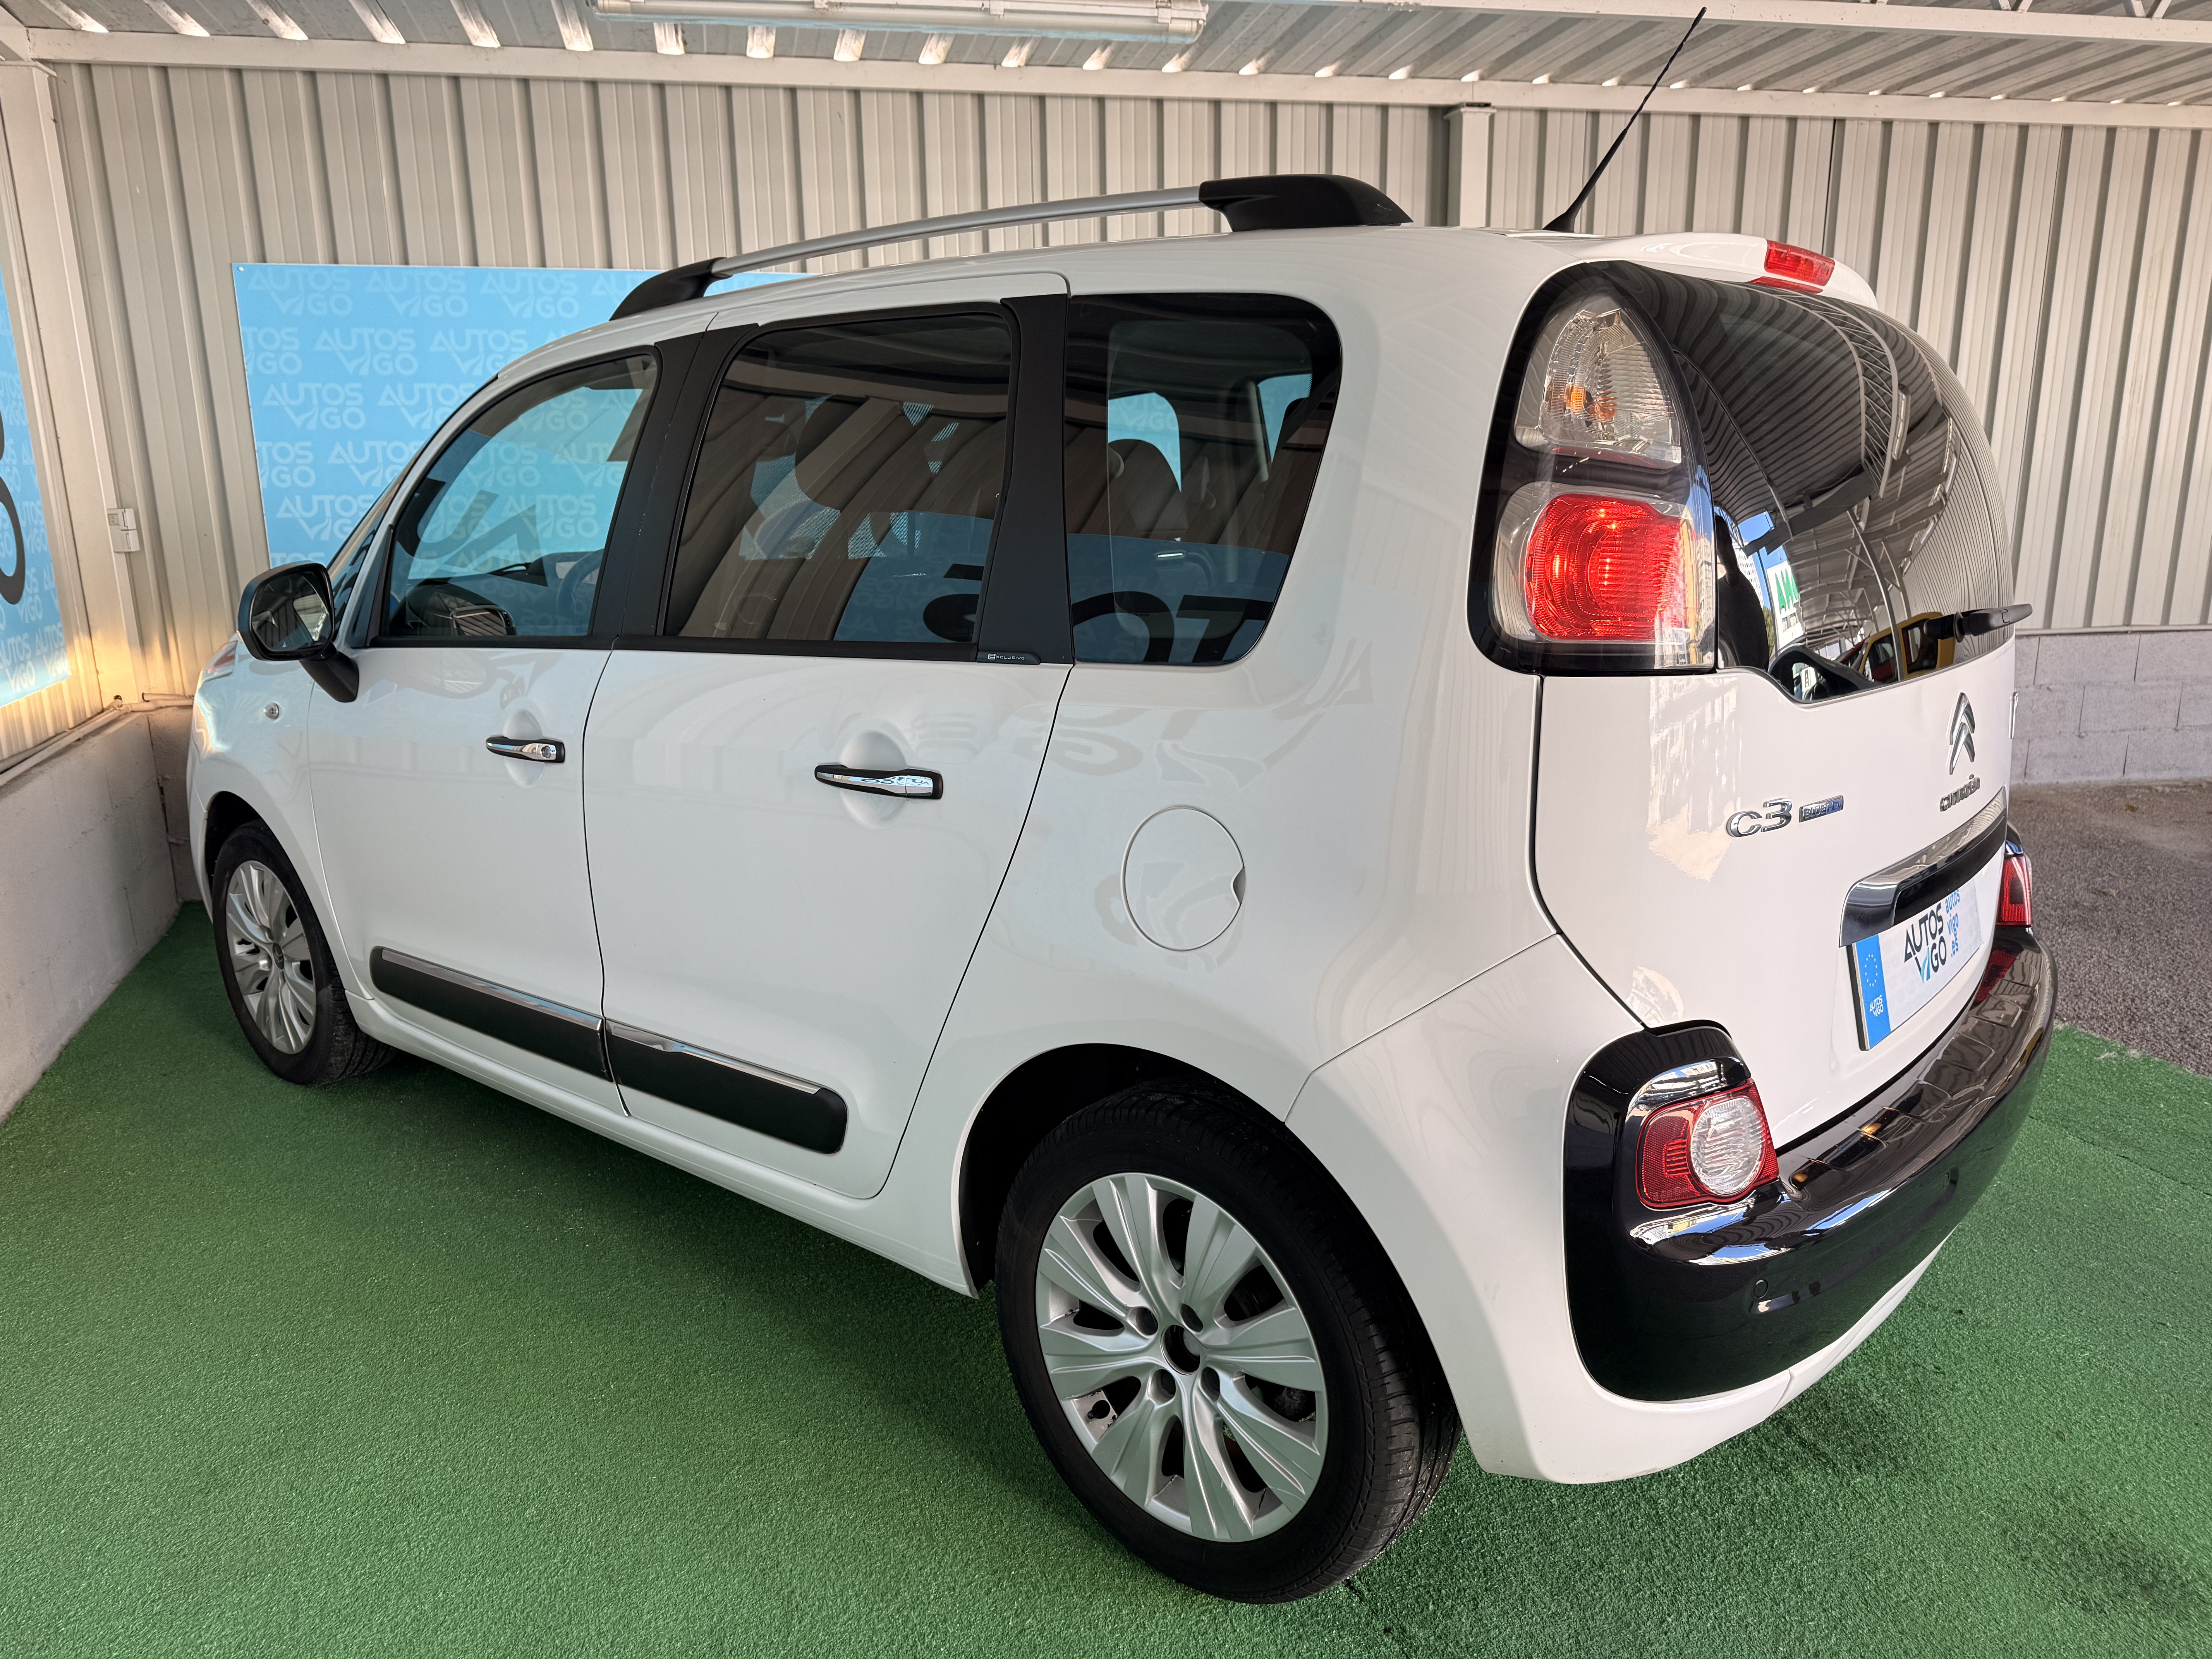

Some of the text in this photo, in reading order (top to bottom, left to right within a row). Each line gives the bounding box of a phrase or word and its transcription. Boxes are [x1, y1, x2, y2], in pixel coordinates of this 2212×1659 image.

[242, 326, 300, 350] TOS
[314, 328, 416, 351] AUTOS
[246, 351, 302, 375] IGO
[262, 383, 364, 405] AUTOS
[284, 407, 366, 429] VIGO
[257, 441, 313, 464] TOS
[1725, 797, 1793, 837] C3
[1904, 902, 1944, 963] AUTOS
[1914, 936, 1947, 984] VIGO
[1869, 994, 1882, 1012] AUTOS
[1872, 1004, 1884, 1017] VIGO
